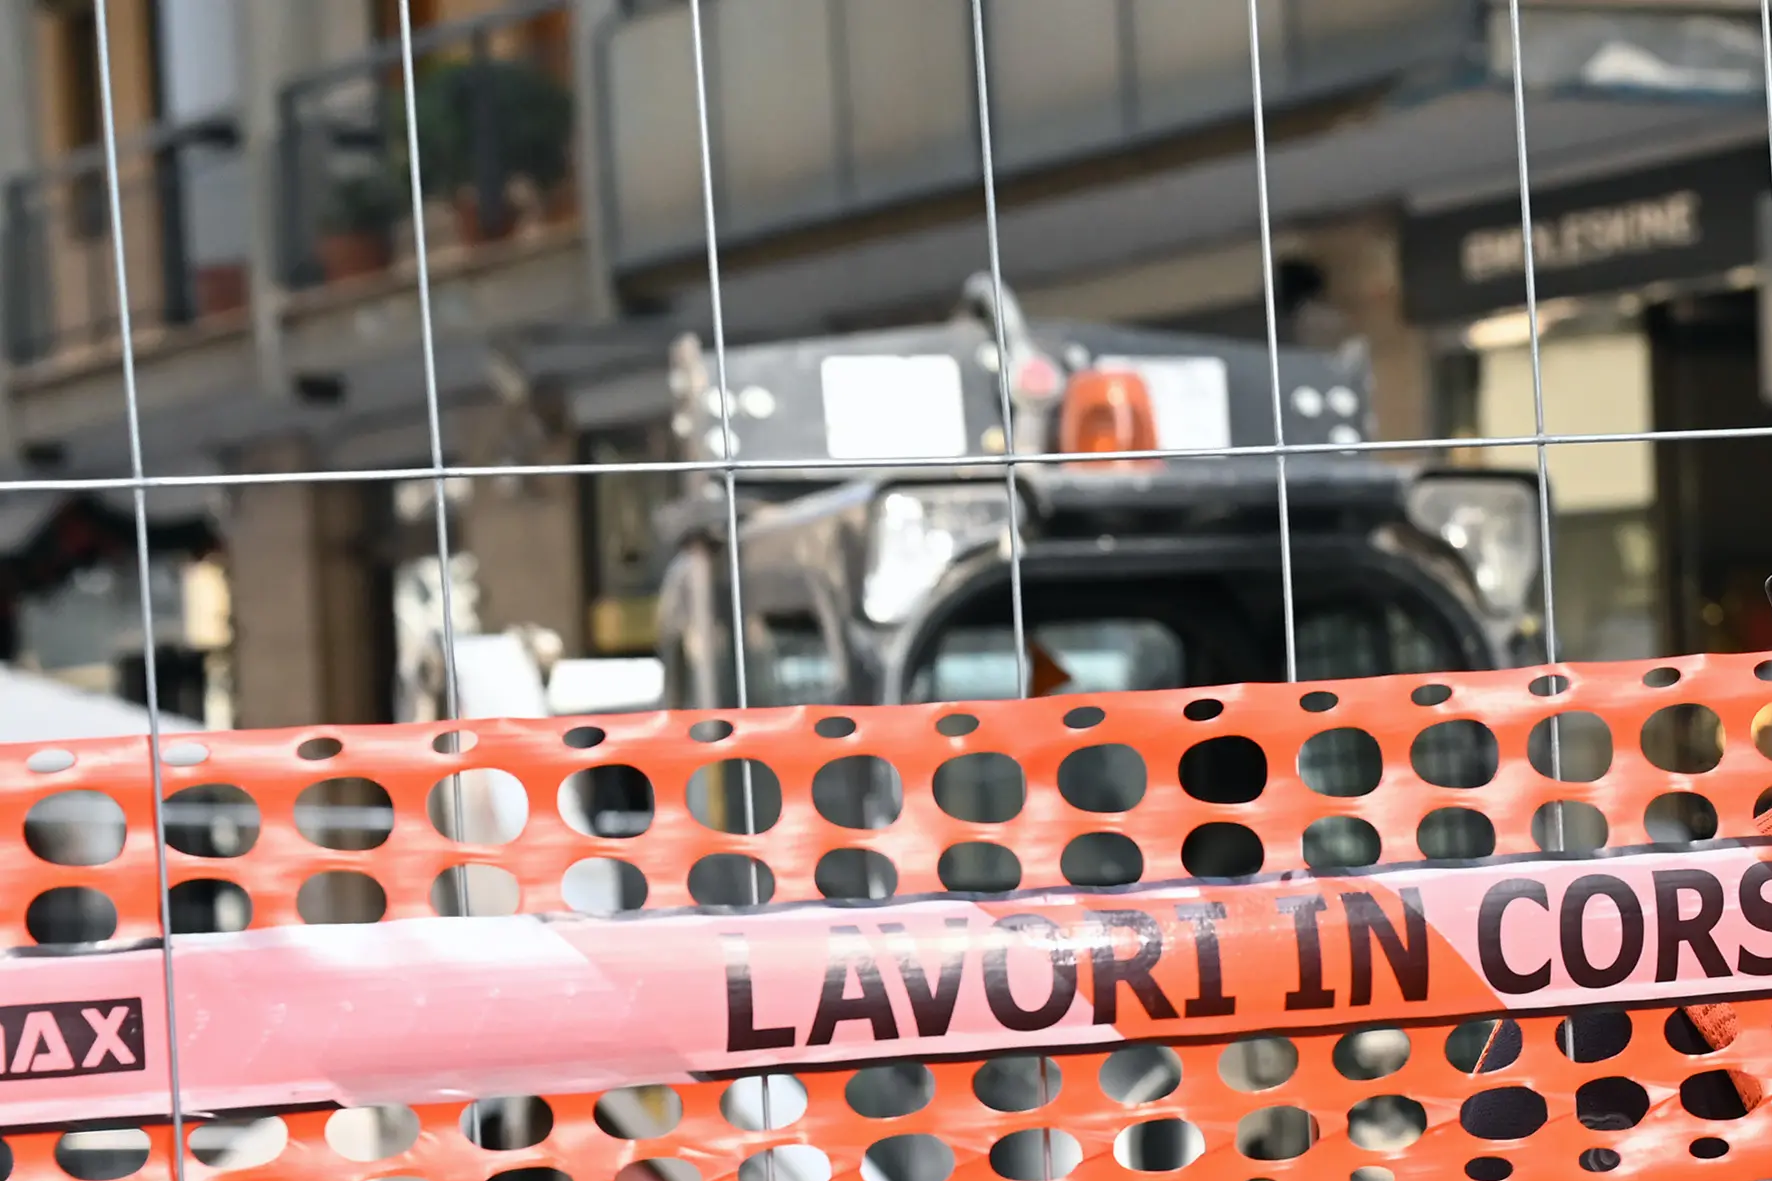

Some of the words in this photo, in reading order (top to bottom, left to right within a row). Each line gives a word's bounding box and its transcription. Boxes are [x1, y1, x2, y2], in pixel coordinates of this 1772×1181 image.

[717, 900, 1236, 1053] LAVORI
[1276, 886, 1430, 1011] IN
[0, 1006, 137, 1075] AX
